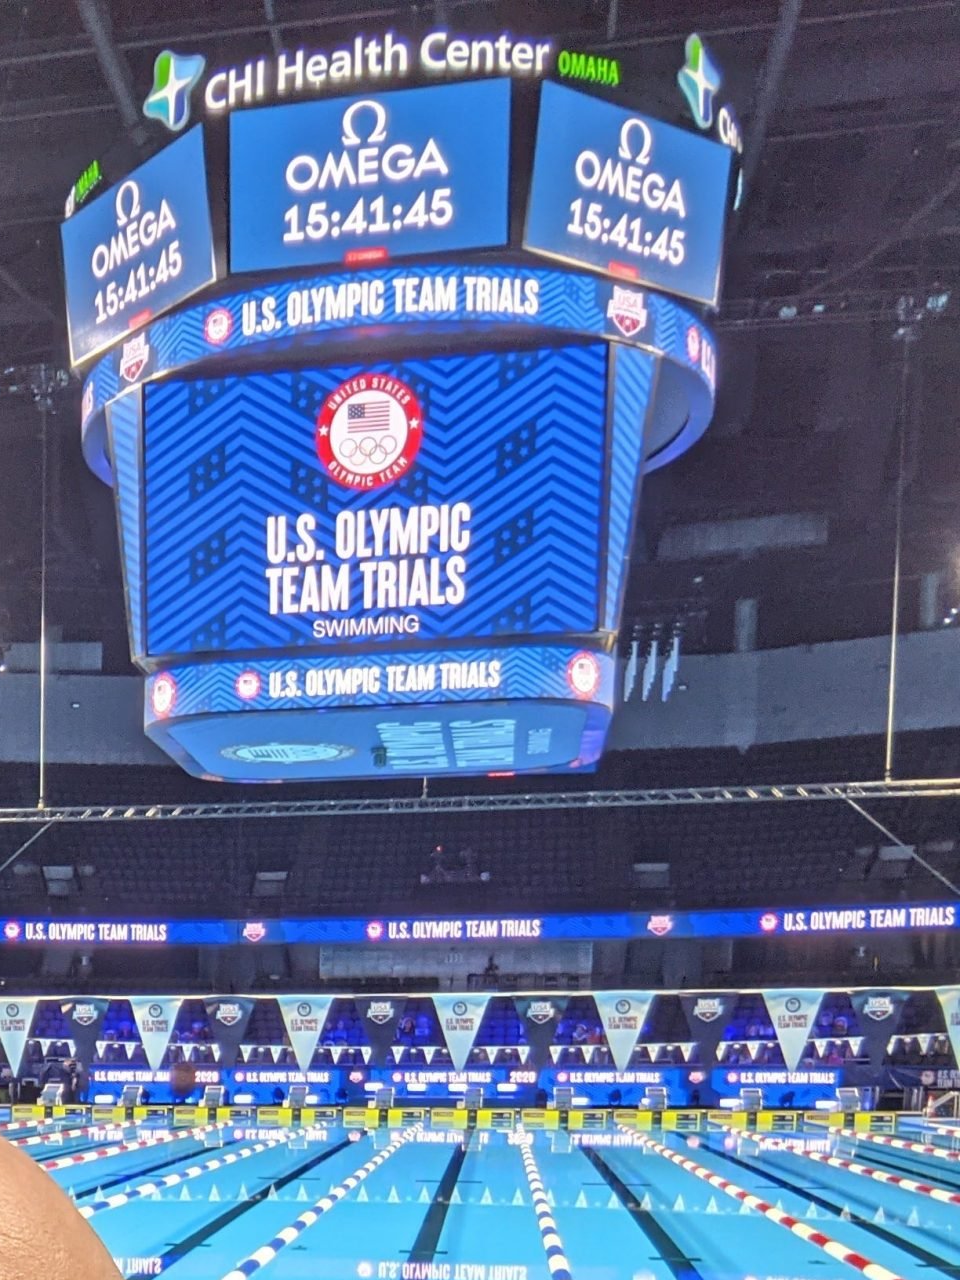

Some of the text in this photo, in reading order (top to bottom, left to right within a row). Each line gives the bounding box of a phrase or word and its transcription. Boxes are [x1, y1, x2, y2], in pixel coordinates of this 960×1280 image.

[205, 31, 549, 110] CHI Health Center
[558, 50, 620, 86] OMAHA
[286, 137, 448, 192] OMEGA
[575, 150, 686, 218] OMEGA
[283, 187, 453, 242] 15:41:45
[91, 198, 177, 279] OMEGA
[566, 198, 686, 266] 15:41:45
[94, 240, 183, 325] 15:41:45
[241, 275, 539, 336] U.S. OLYMPIC TEAM TRIALS
[327, 377, 411, 411] UNITED STATES
[327, 456, 408, 487] OLYMPIC TEAM
[266, 502, 470, 565] U.S. OLYMPIC
[265, 555, 465, 615] TEAM TRIALS
[312, 614, 420, 639] SWIMMING
[268, 659, 501, 698] U.S. OLYMPIC TEAM TRIALS
[25, 921, 167, 942] U.S. OLYMPIC TEAM TRIALS
[388, 918, 541, 940] U.S. OLYMPIC TEAM TRIALS
[783, 906, 955, 932] U.S. OLYMPIC TEAM TRIALS
[135, 1071, 152, 1082] TEAM
[195, 1071, 219, 1082] 2020
[307, 1071, 329, 1082] TRIALS
[468, 1071, 491, 1083] TRIALS
[509, 1071, 536, 1083] 2020
[636, 1071, 660, 1083] TRIALS
[755, 1072, 786, 1083] OLYMPIC
[809, 1072, 835, 1084] TRIALS
